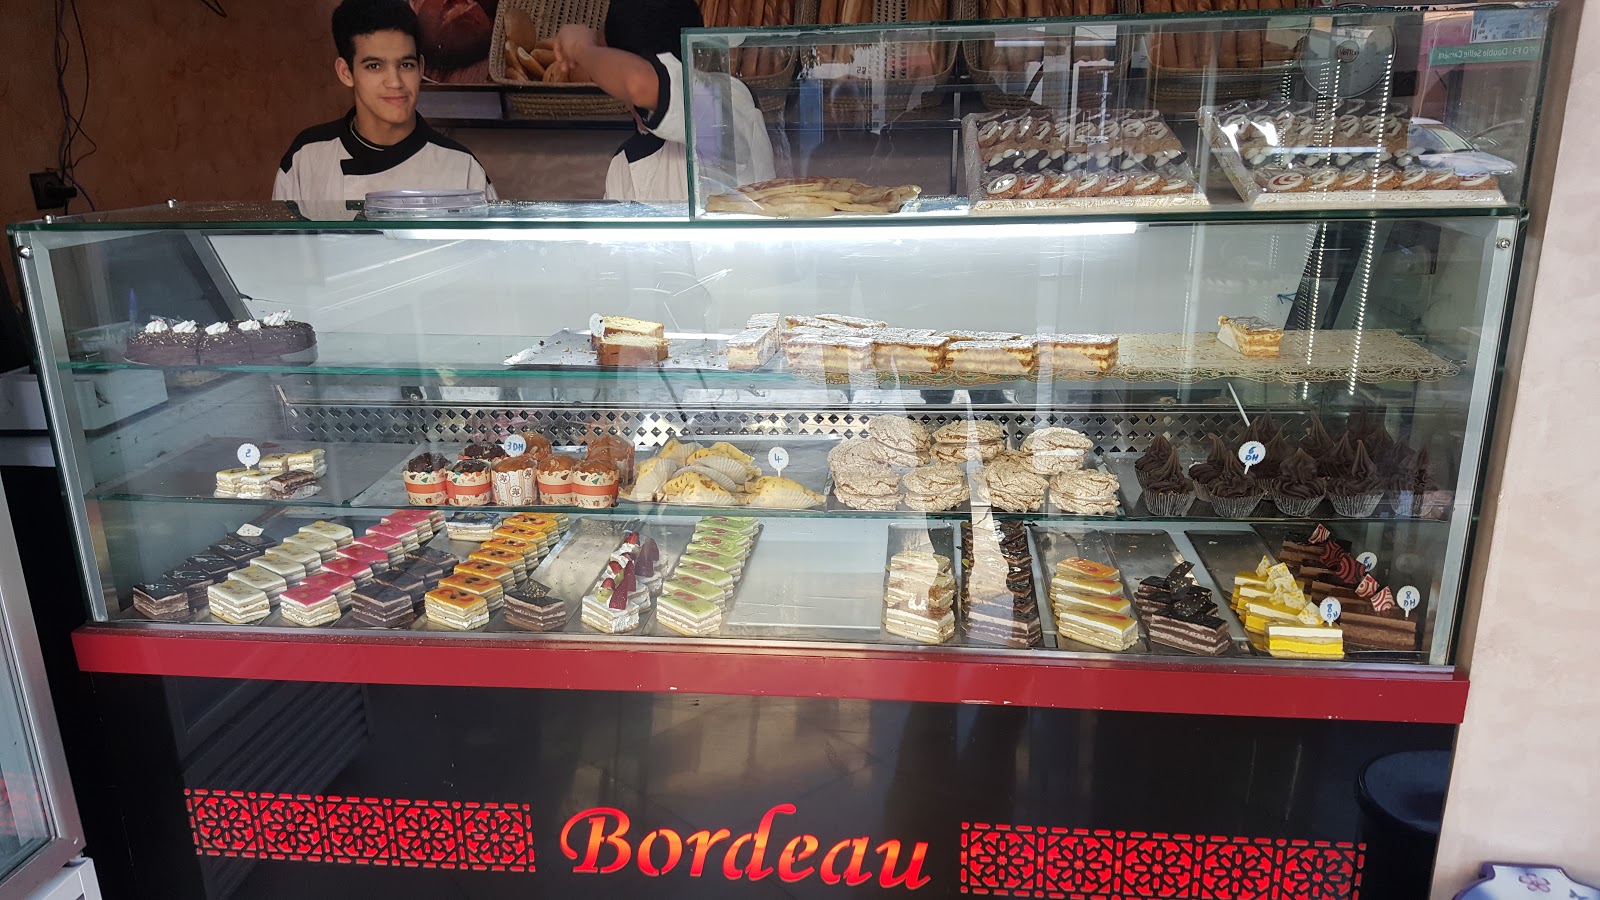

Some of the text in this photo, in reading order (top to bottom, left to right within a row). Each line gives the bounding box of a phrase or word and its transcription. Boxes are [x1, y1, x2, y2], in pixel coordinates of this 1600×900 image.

[1248, 446, 1257, 455] 6
[774, 452, 784, 464] 4
[1245, 453, 1259, 461] DH
[1405, 590, 1412, 600] 8
[1403, 598, 1416, 608] DH
[1326, 603, 1333, 614] 8
[559, 803, 932, 891] Bordeau
